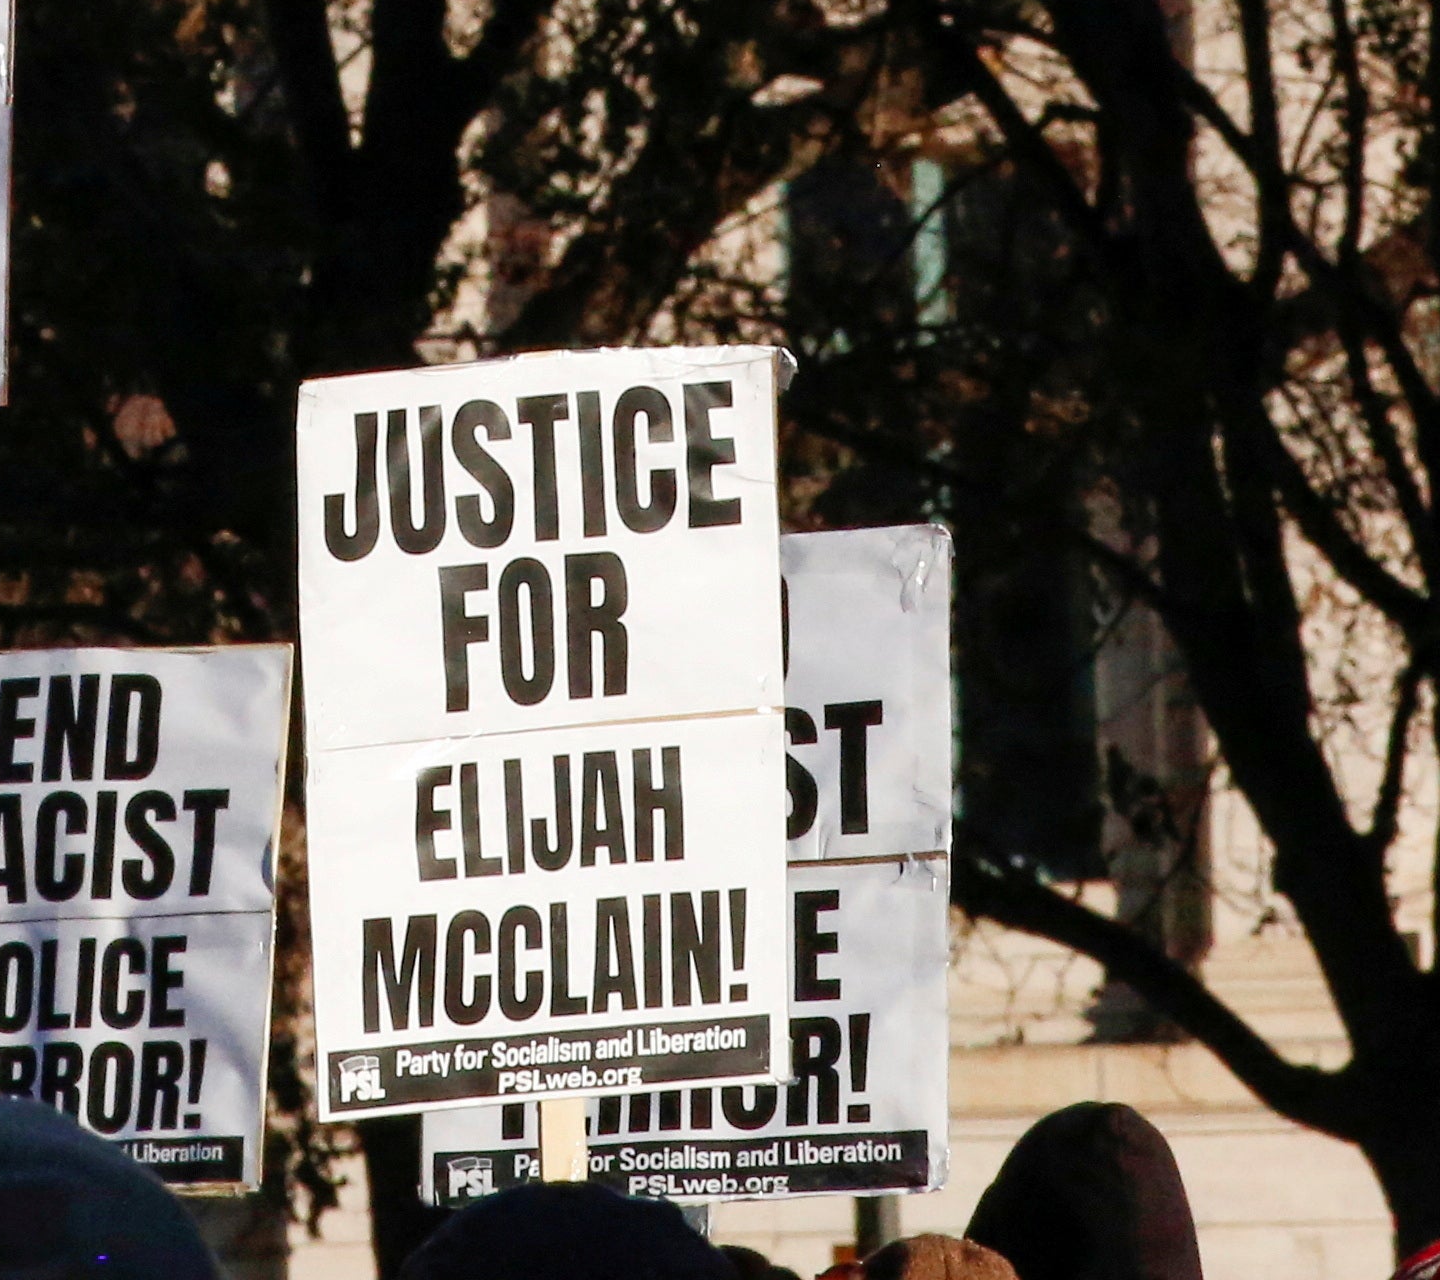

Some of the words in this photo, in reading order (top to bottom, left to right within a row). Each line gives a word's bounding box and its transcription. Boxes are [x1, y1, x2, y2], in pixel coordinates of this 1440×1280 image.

[324, 381, 741, 562] JUSTICE
[439, 552, 628, 713] FOR
[416, 746, 684, 881] ELIJAH
[362, 888, 747, 1033] MCCLAIN!
[396, 1049, 452, 1078] Party
[454, 1043, 488, 1070] for
[491, 1034, 591, 1068] Socialism
[595, 1029, 634, 1061] and
[637, 1024, 747, 1056] Liberation
[340, 1071, 386, 1102] PSL
[498, 1064, 643, 1094] PSLweb.org
[132, 1143, 224, 1163] Liberation
[619, 1142, 730, 1171] Socialism
[736, 1142, 779, 1168] and
[783, 1140, 902, 1167] Liberation
[449, 1166, 499, 1197] PSL
[629, 1174, 789, 1196] PSLweb.org
